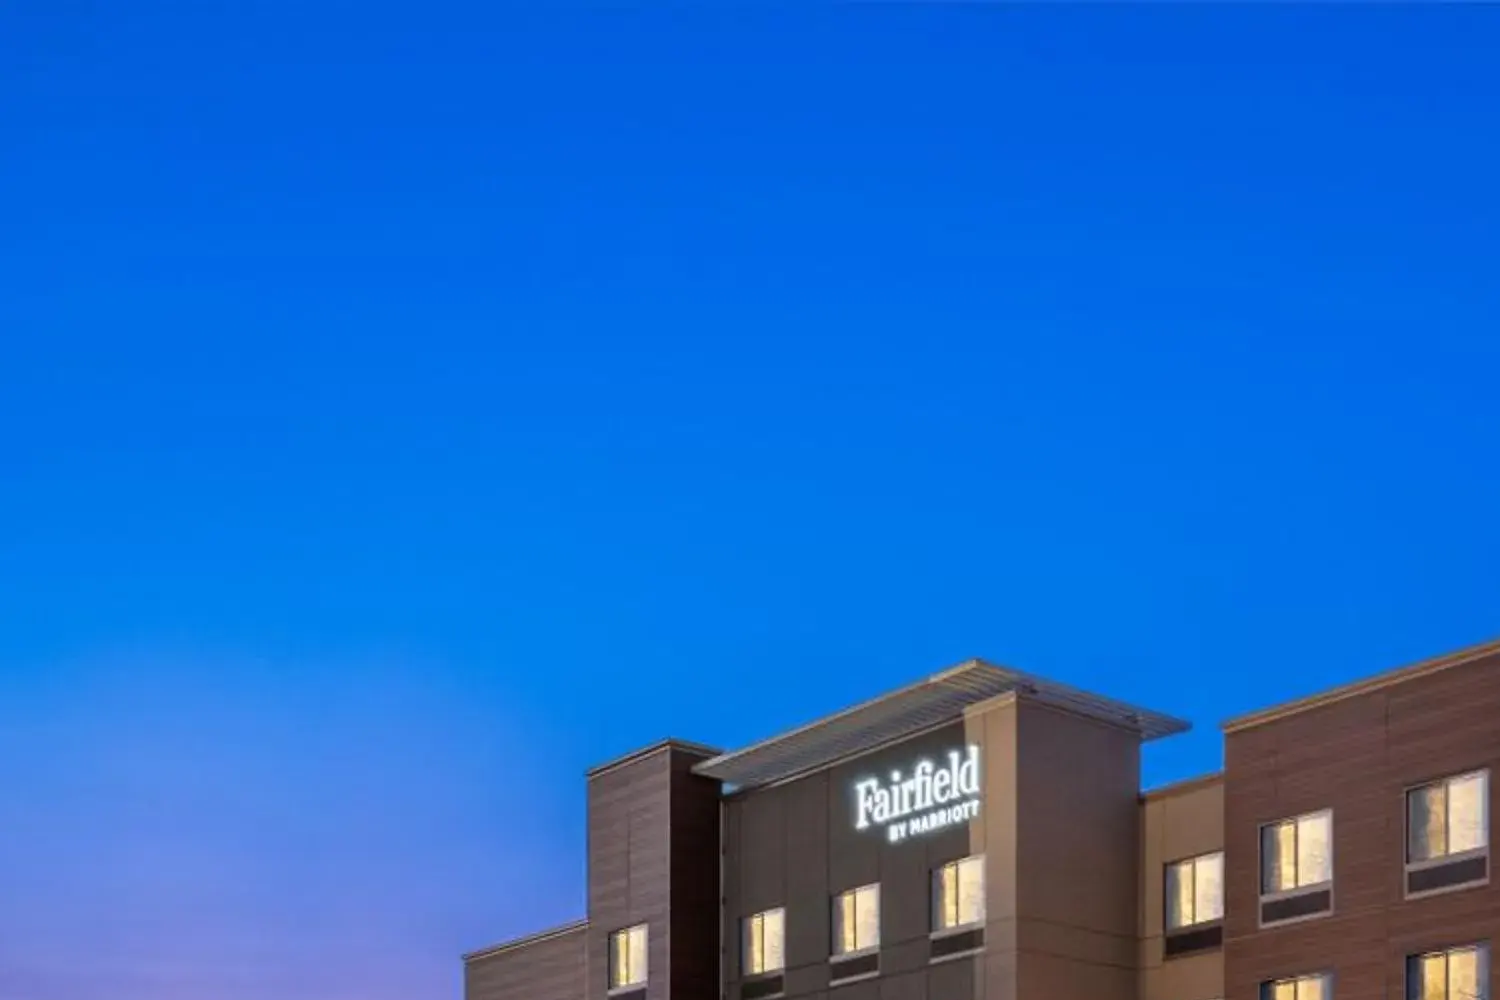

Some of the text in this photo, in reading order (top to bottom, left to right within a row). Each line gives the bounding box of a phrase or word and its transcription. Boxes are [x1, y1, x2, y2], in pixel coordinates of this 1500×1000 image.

[855, 744, 980, 829] Fairfield
[888, 799, 980, 842] BY MARRIOTT
